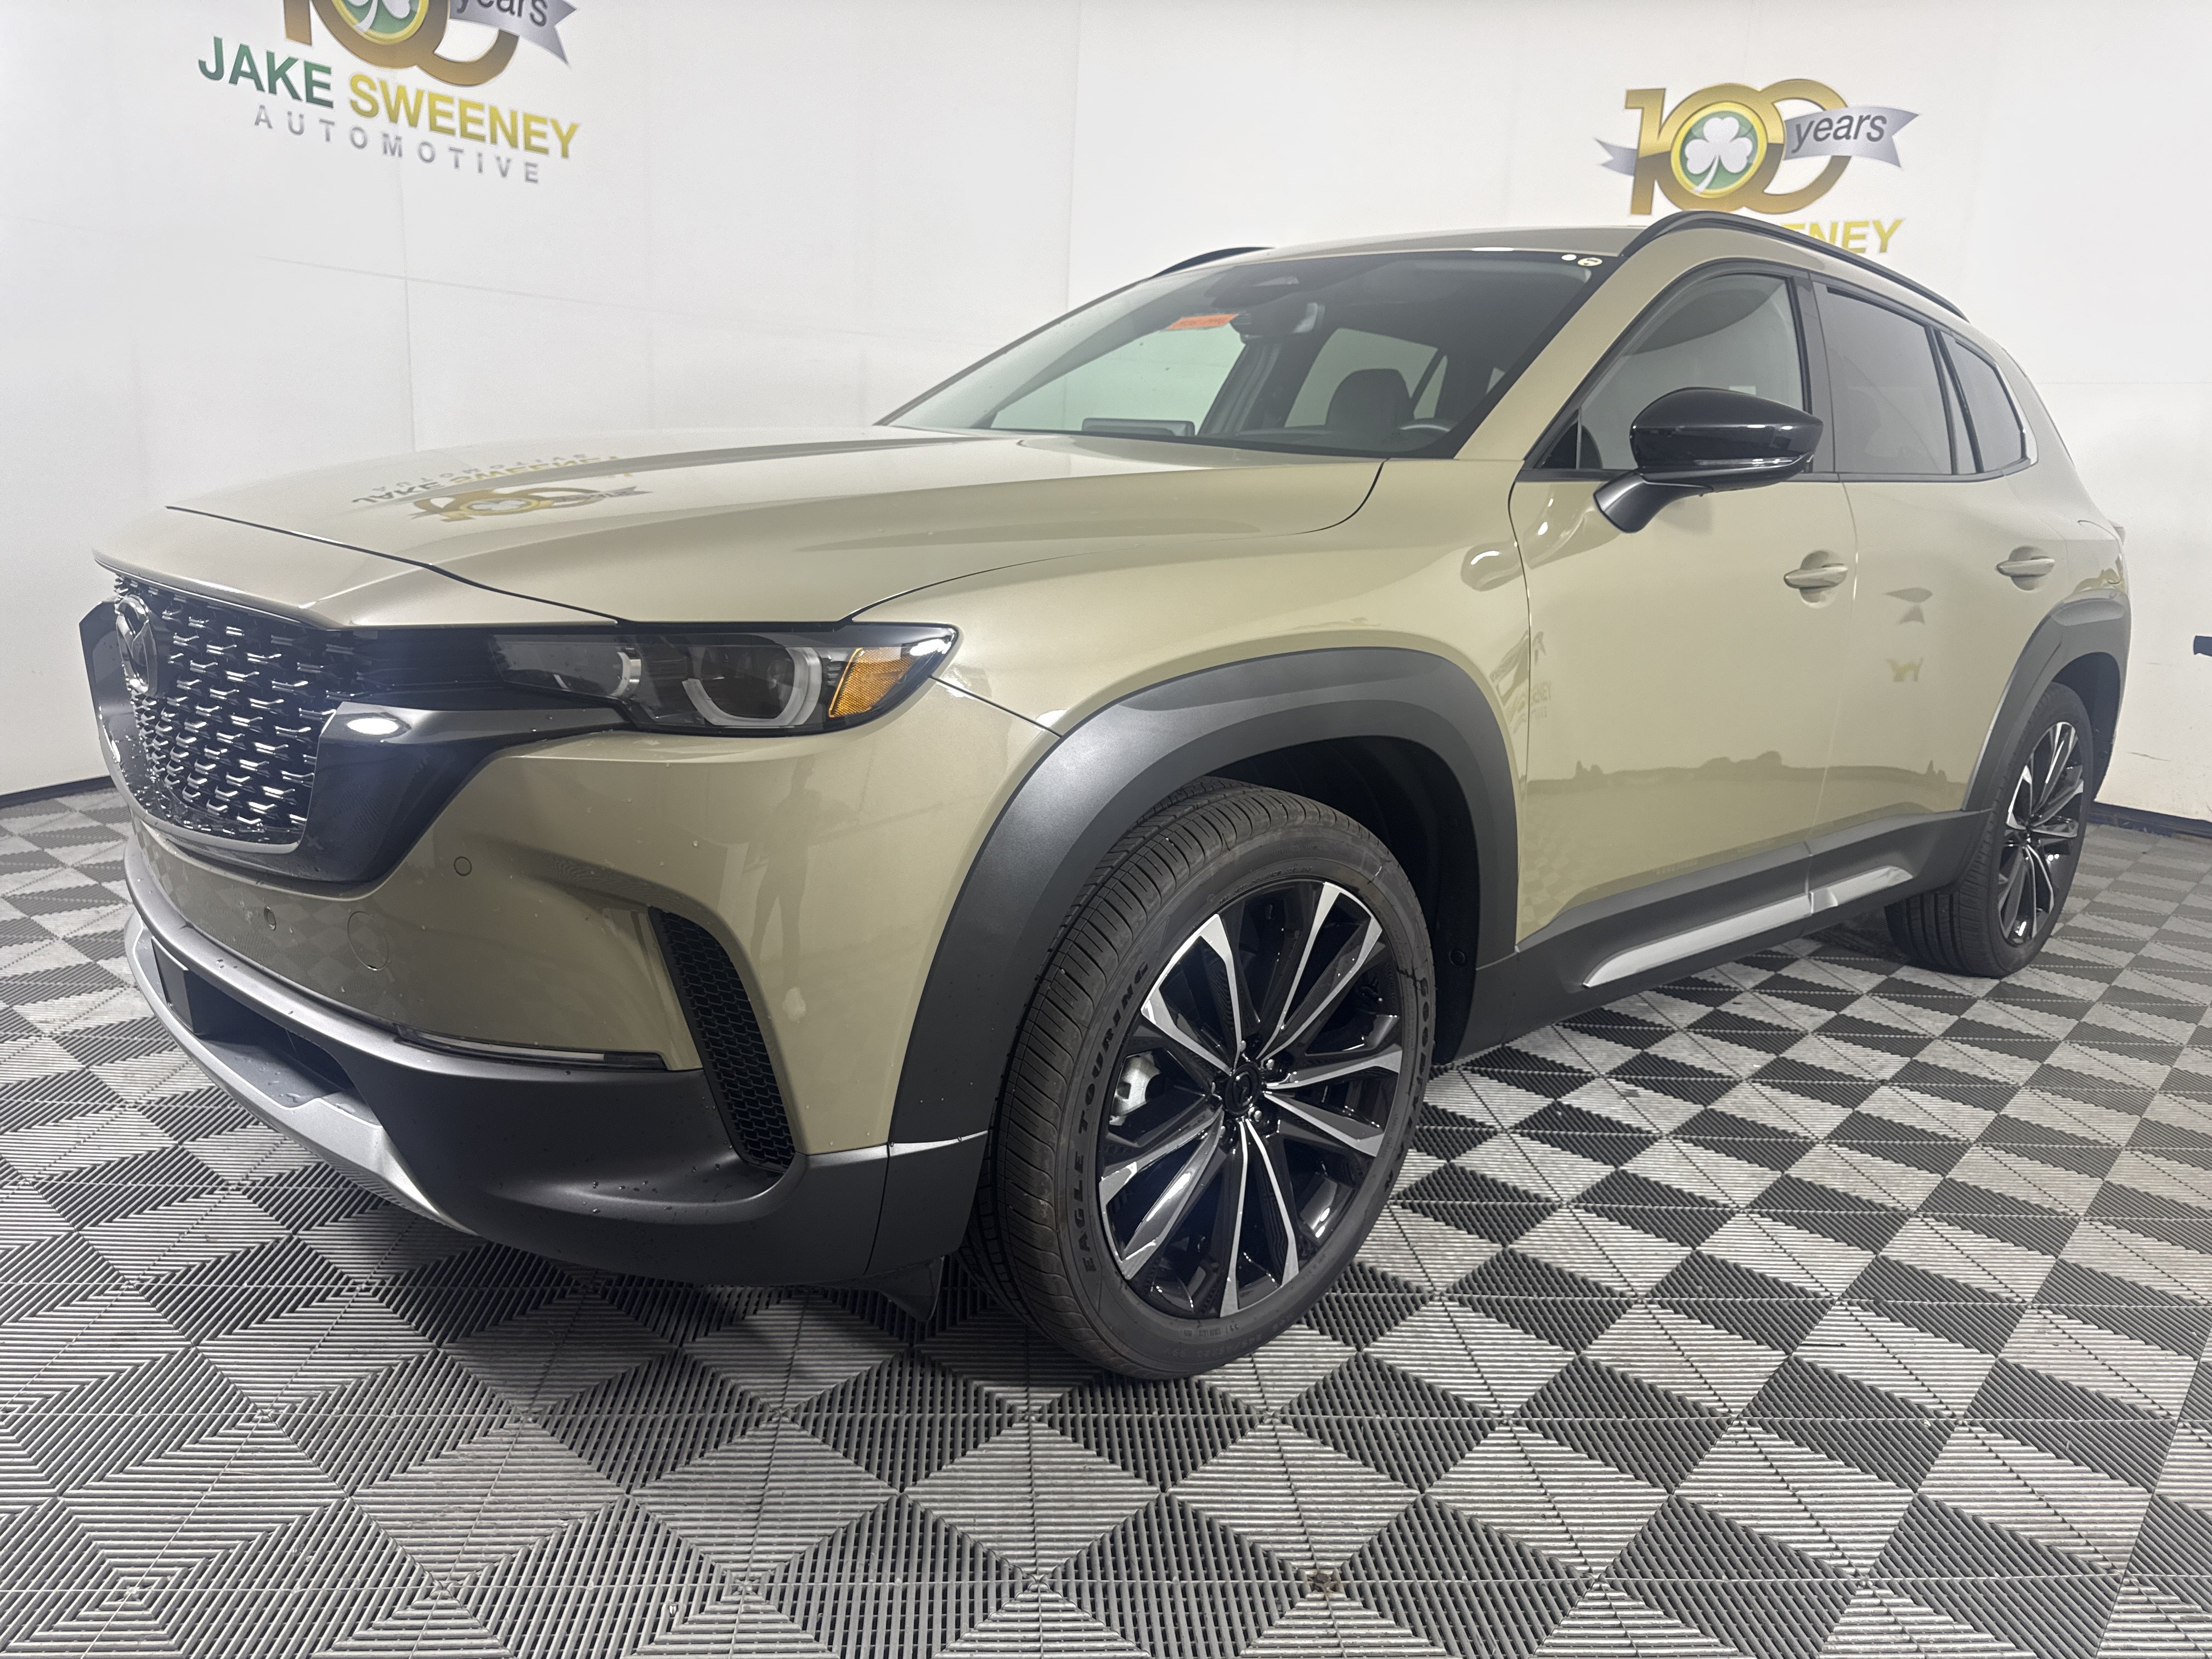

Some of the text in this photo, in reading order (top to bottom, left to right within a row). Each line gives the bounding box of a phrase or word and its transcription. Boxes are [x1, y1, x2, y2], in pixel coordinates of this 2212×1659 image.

[198, 36, 580, 159] JAKE SWEENEY
[254, 104, 540, 183] AUTOMOTIVE
[1624, 78, 1887, 215] 100 years
[1782, 219, 1904, 253] NEY
[1074, 961, 1148, 1273] EAGLE TOURING
